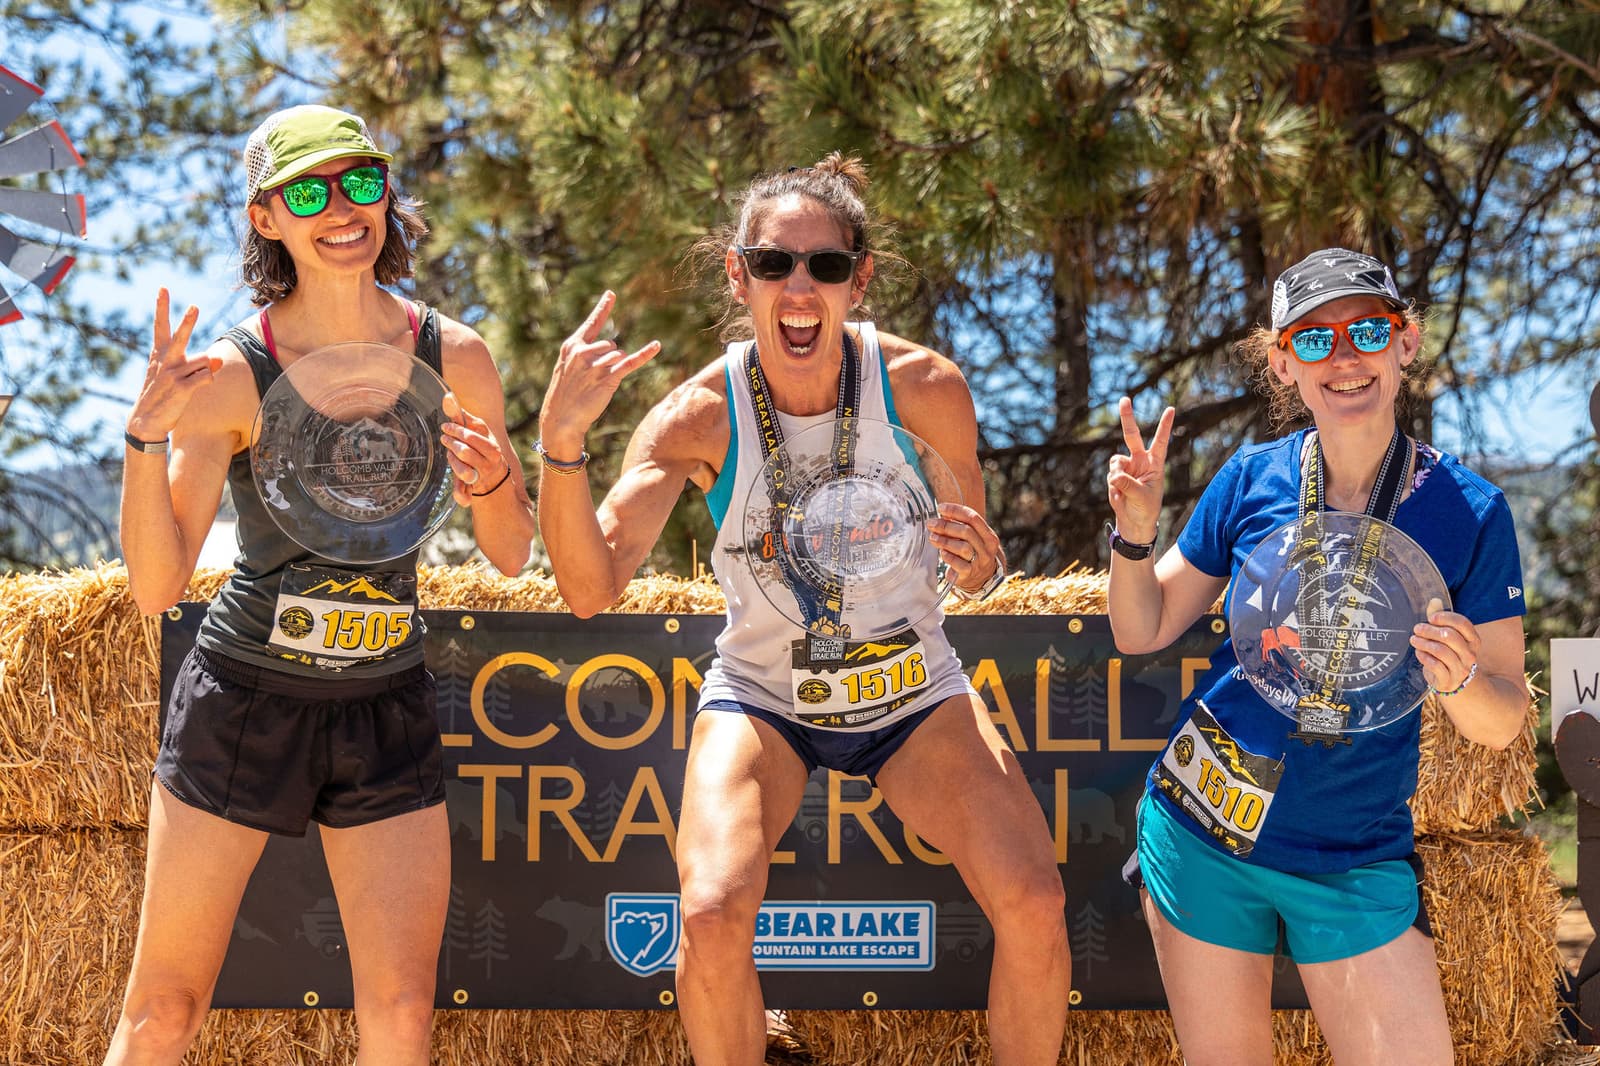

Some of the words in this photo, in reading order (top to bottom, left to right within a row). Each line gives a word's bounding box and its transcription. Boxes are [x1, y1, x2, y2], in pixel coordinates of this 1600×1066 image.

[750, 367, 761, 391] BIG
[755, 393, 770, 429] BEAR
[320, 464, 372, 475] HOLCOMB
[373, 461, 410, 472] VALLEY
[341, 474, 369, 484] TRAIL
[1306, 474, 1318, 508] LAKE,
[321, 609, 411, 651] 1505
[1351, 630, 1389, 641] VLLEY
[840, 652, 927, 704] 1516
[1197, 757, 1265, 832] 1510
[755, 912, 837, 937] BEAR
[842, 912, 921, 937] LAKE
[820, 945, 858, 956] LAKE
[861, 945, 916, 956] ESCAPE
